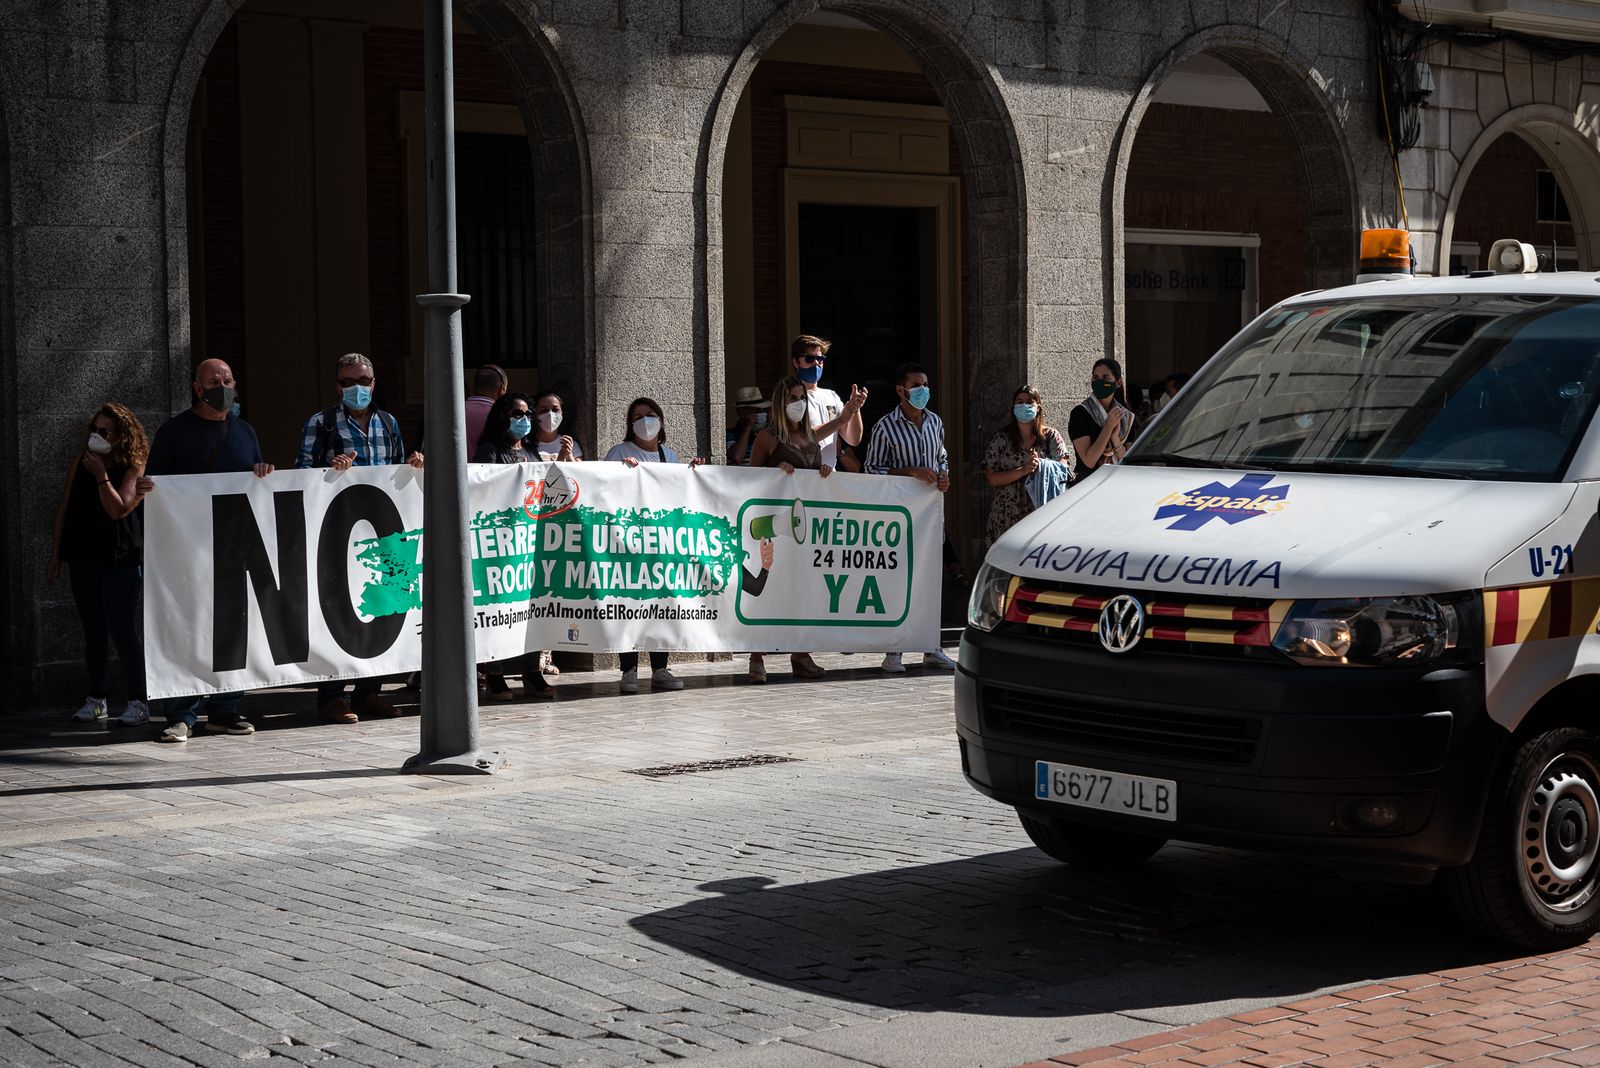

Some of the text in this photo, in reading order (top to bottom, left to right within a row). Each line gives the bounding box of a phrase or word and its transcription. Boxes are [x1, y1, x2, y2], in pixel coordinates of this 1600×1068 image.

[1125, 269, 1209, 289] sche Bank
[471, 523, 723, 560] IERRE DE URGENCIAS
[811, 512, 901, 547] MÉDICO
[485, 555, 536, 595] ROCÍO
[541, 560, 557, 587] Y
[565, 555, 725, 591] MATALASCAÑAS
[813, 549, 898, 570] 24 HORAS
[1529, 544, 1575, 577] U-21
[212, 484, 408, 672] NO
[823, 574, 886, 614] YA
[474, 602, 718, 630] sTrabajamosPorAlmonteElRocíoMatalascañas
[1053, 769, 1113, 804] 6677
[1123, 780, 1169, 814] JLB
